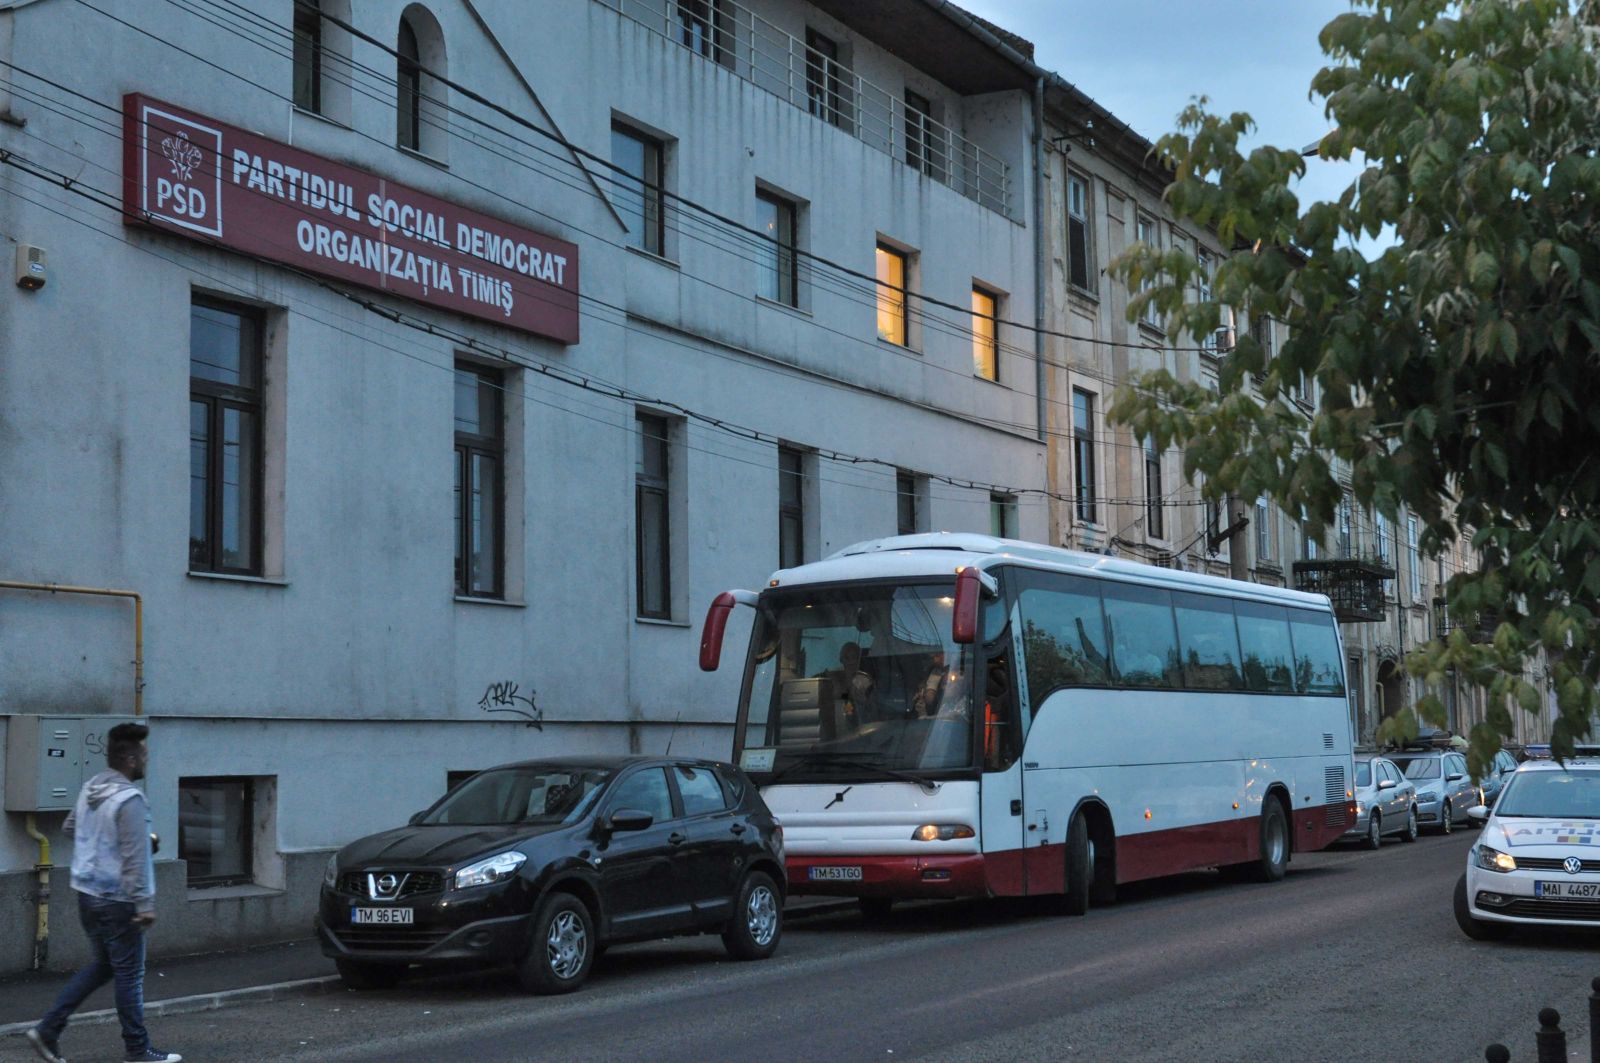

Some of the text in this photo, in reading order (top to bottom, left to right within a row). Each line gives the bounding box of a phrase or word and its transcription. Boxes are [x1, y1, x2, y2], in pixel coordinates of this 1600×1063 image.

[157, 177, 206, 219] PSD
[233, 148, 566, 285] PARTIDUL SOCIAL DEMOCRAT
[814, 867, 827, 878] TM
[1542, 883, 1561, 896] MAI
[358, 908, 411, 923] TM 96 EVI
